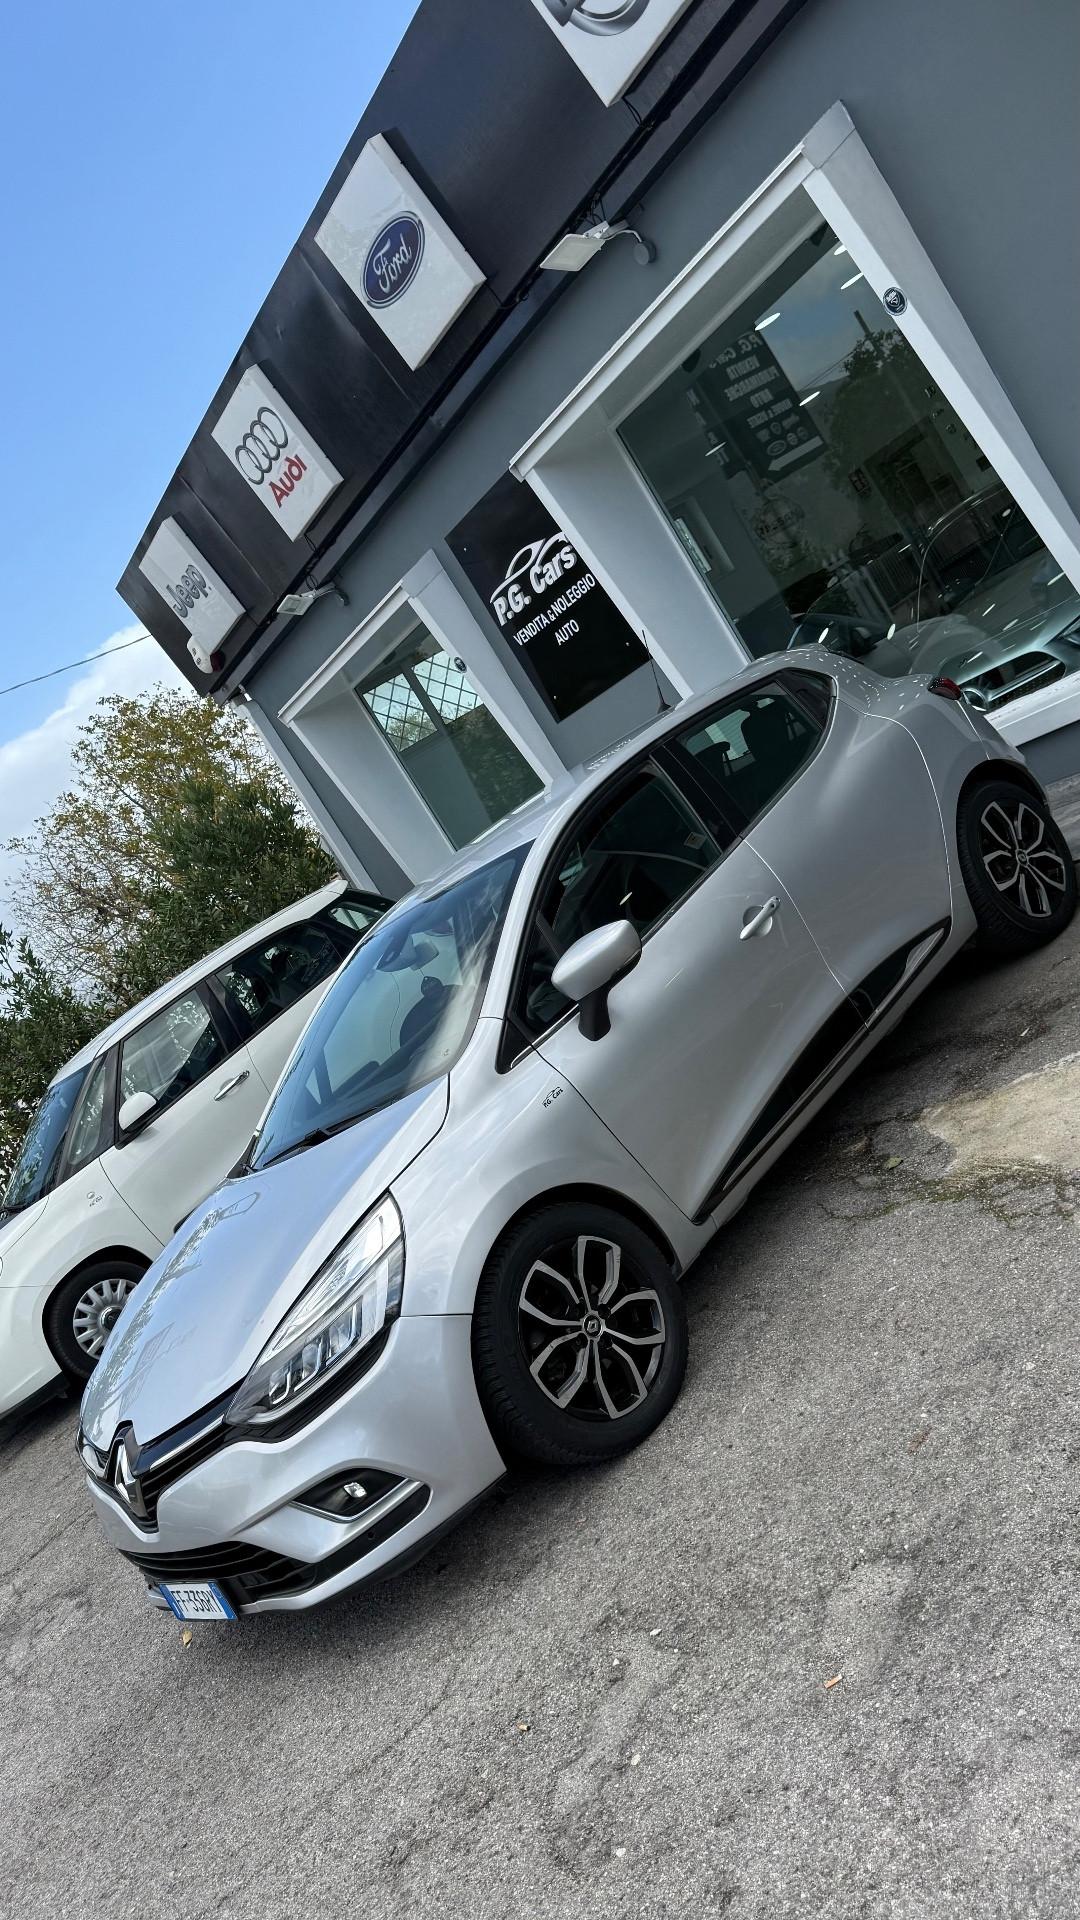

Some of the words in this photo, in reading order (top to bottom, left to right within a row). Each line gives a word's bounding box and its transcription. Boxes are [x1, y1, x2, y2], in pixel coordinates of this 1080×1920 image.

[372, 232, 413, 294] Ford
[268, 453, 308, 509] Audi
[166, 564, 209, 619] Jeep
[493, 583, 532, 627] P.G.
[529, 544, 578, 594] Cars
[550, 573, 597, 617] NOLEGGIO
[512, 612, 551, 646] VENDITA
[547, 609, 557, 623] &
[554, 619, 580, 646] AUTO
